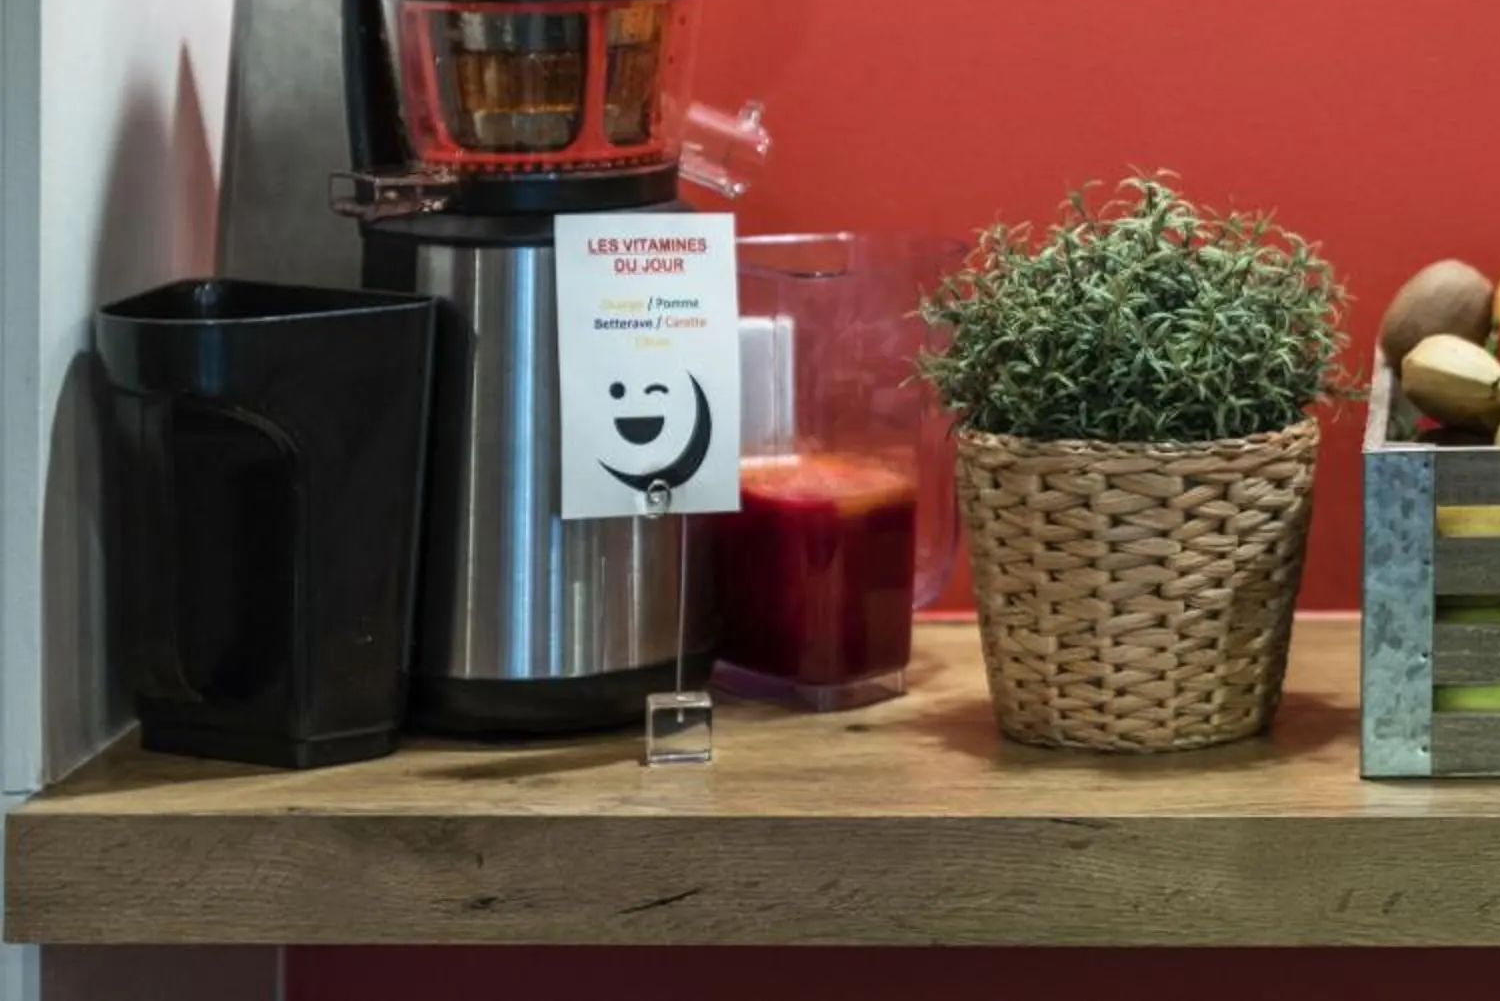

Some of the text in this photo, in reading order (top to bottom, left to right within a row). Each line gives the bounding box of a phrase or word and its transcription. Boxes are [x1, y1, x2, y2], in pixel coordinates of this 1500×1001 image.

[587, 237, 707, 253] LES VITAMINES
[614, 258, 684, 273] DU JOUR
[594, 318, 653, 330] Betterave
